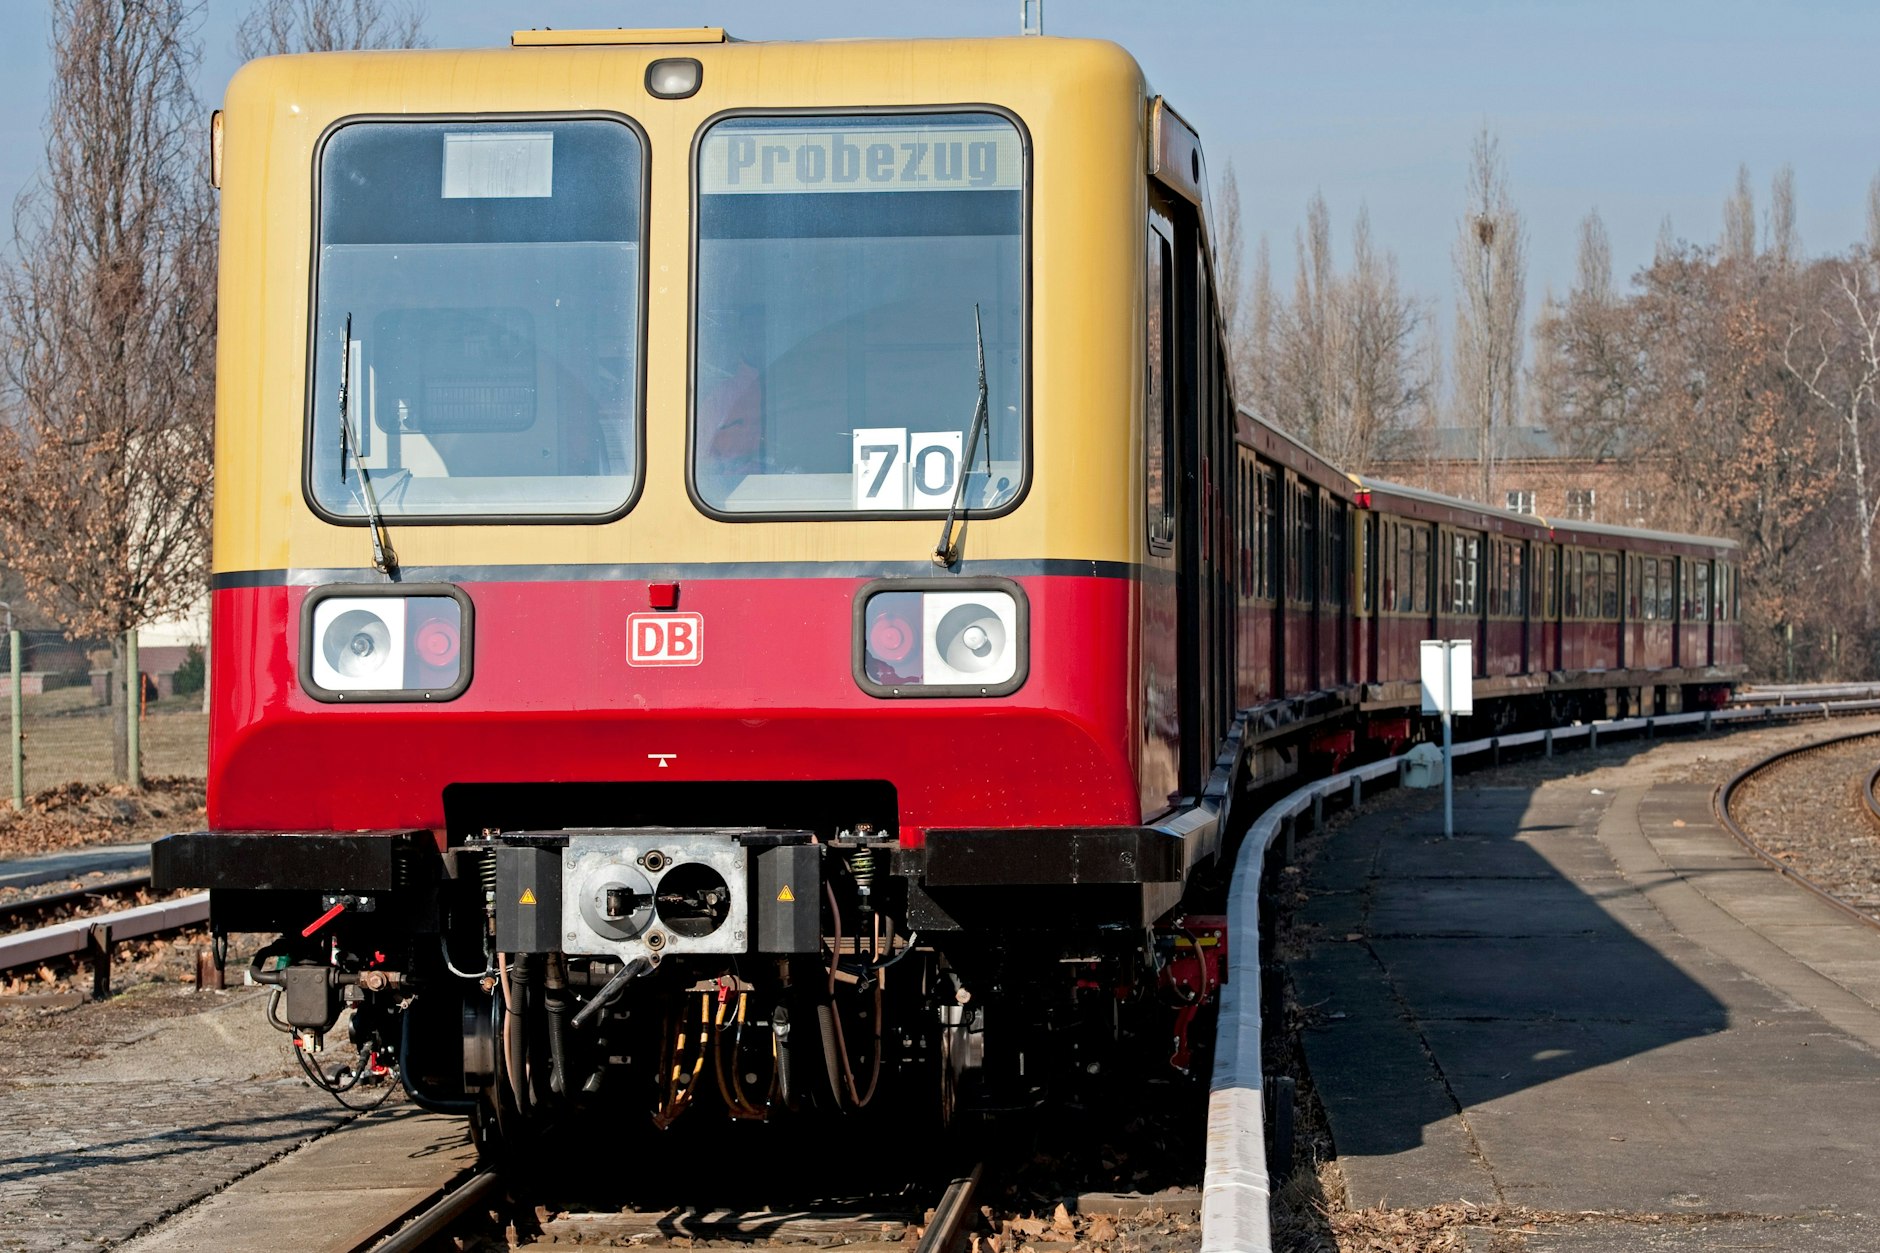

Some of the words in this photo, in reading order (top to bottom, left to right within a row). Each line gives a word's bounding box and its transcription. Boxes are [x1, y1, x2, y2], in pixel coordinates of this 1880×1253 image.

[727, 133, 998, 186] Probezug
[860, 444, 954, 498] 70
[637, 621, 693, 657] DB
